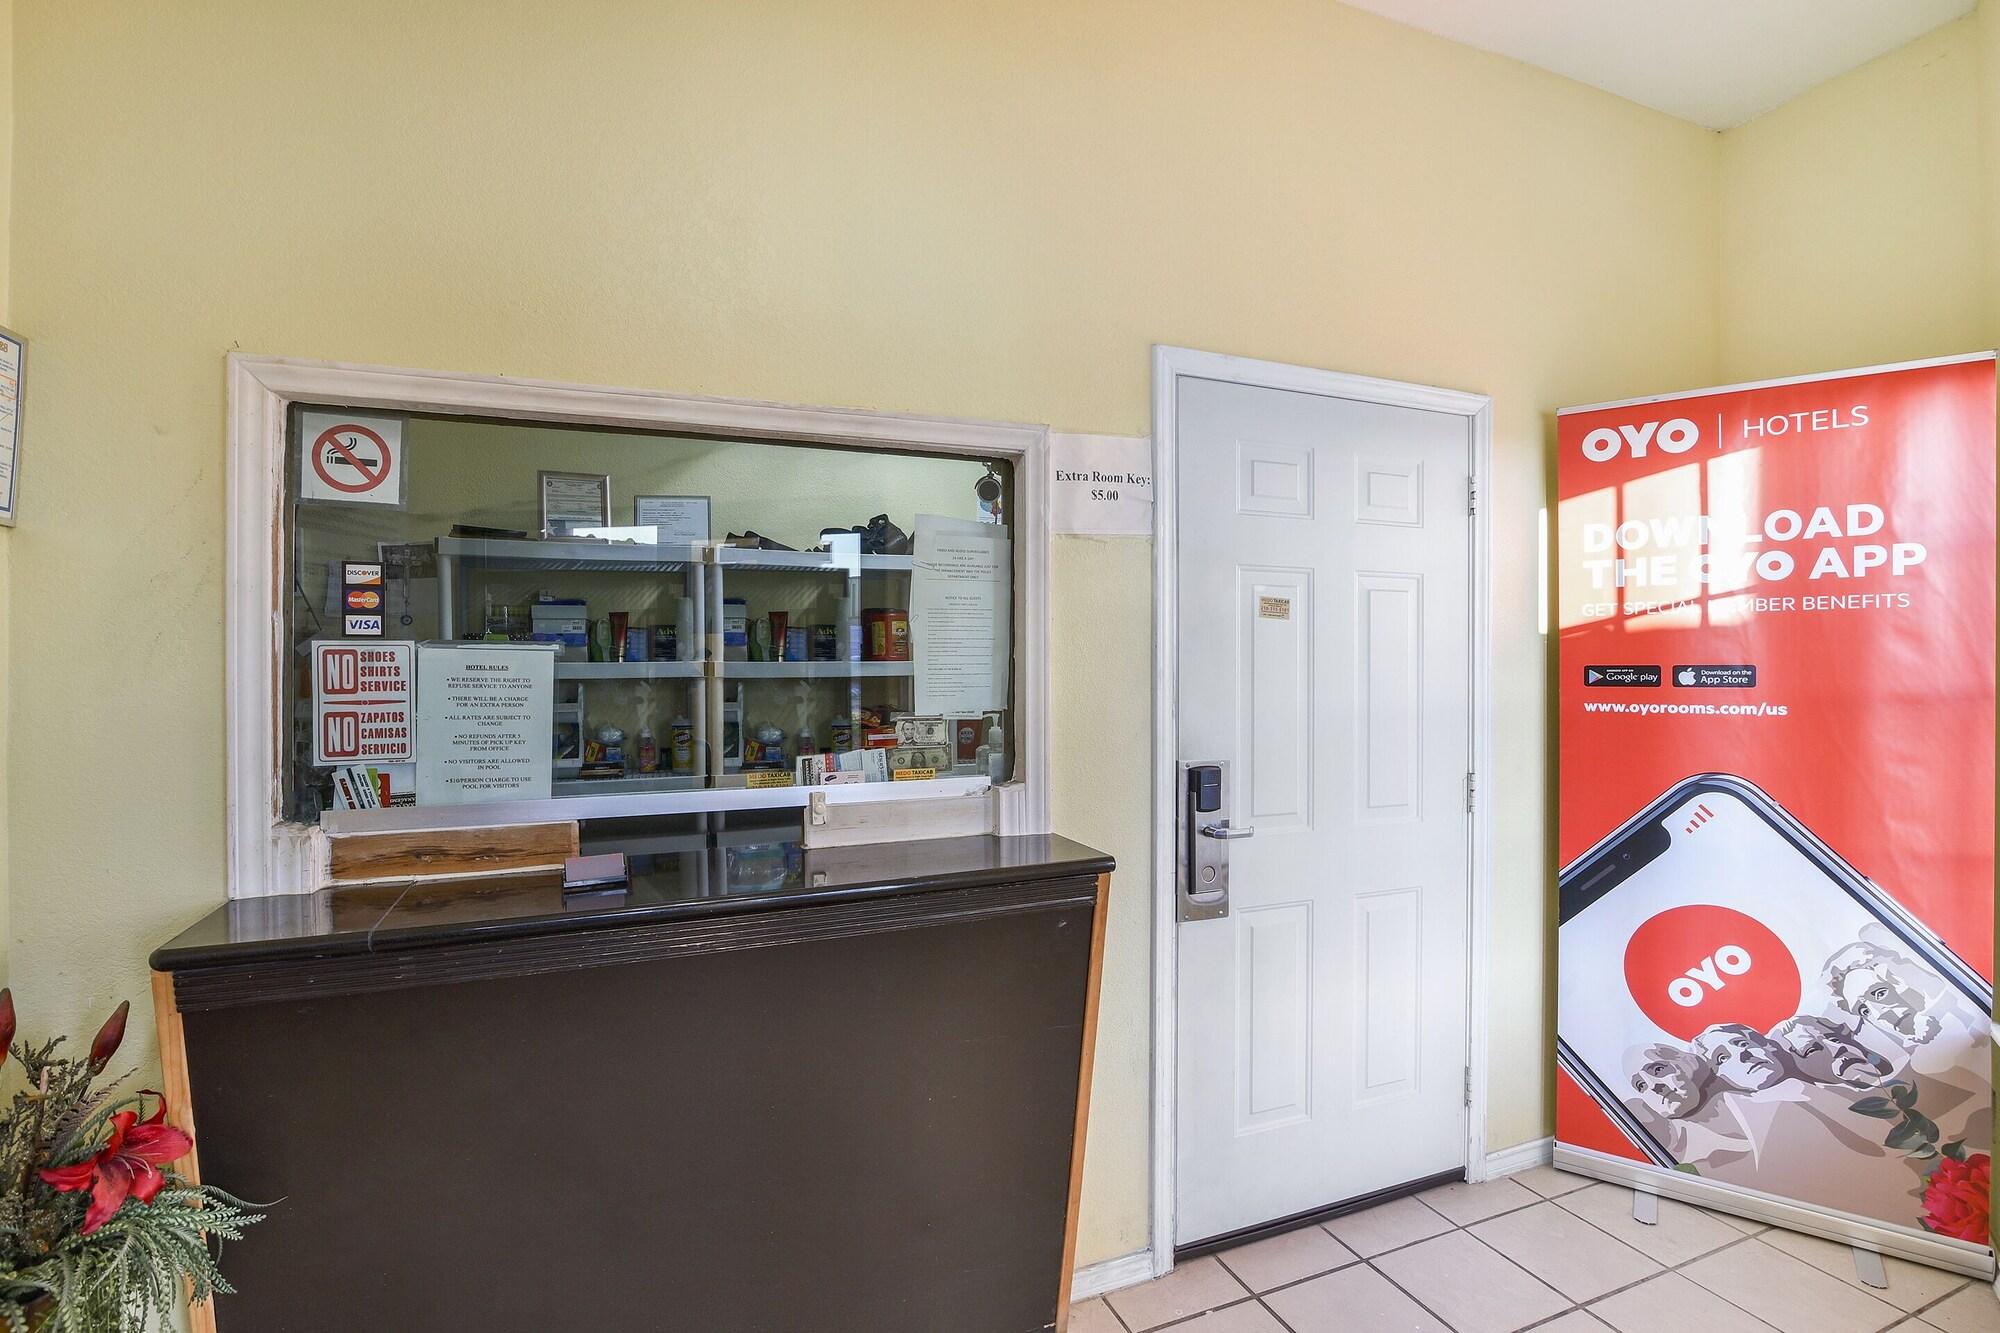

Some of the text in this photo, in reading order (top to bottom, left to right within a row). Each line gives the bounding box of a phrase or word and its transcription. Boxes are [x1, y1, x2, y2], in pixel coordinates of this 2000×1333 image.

[1581, 405, 1870, 463] OYO HOTELS
[1055, 470, 1151, 488] Extra Room Key:
[1091, 489, 1119, 502] $5.00
[1583, 554, 1678, 589] THE
[1809, 542, 1927, 580] APP
[347, 569, 380, 577] DISCOVER
[1582, 592, 1910, 617] GET SPECIAL MBER BENEFITS
[348, 619, 380, 630] VISA
[360, 651, 396, 663] SHOES
[325, 653, 354, 690] NO
[360, 665, 401, 677] SHIRTS
[1606, 672, 1658, 683] Google play
[360, 680, 407, 692] SERVICE
[1700, 675, 1749, 685] App Store
[1584, 701, 1788, 717] www.oyorooms.com/us
[360, 711, 405, 723] ZAPATOS
[326, 716, 354, 753] NO
[361, 727, 407, 740] CAMISAS
[361, 742, 407, 755] SERVICIO
[1667, 944, 1752, 1007] OYO
